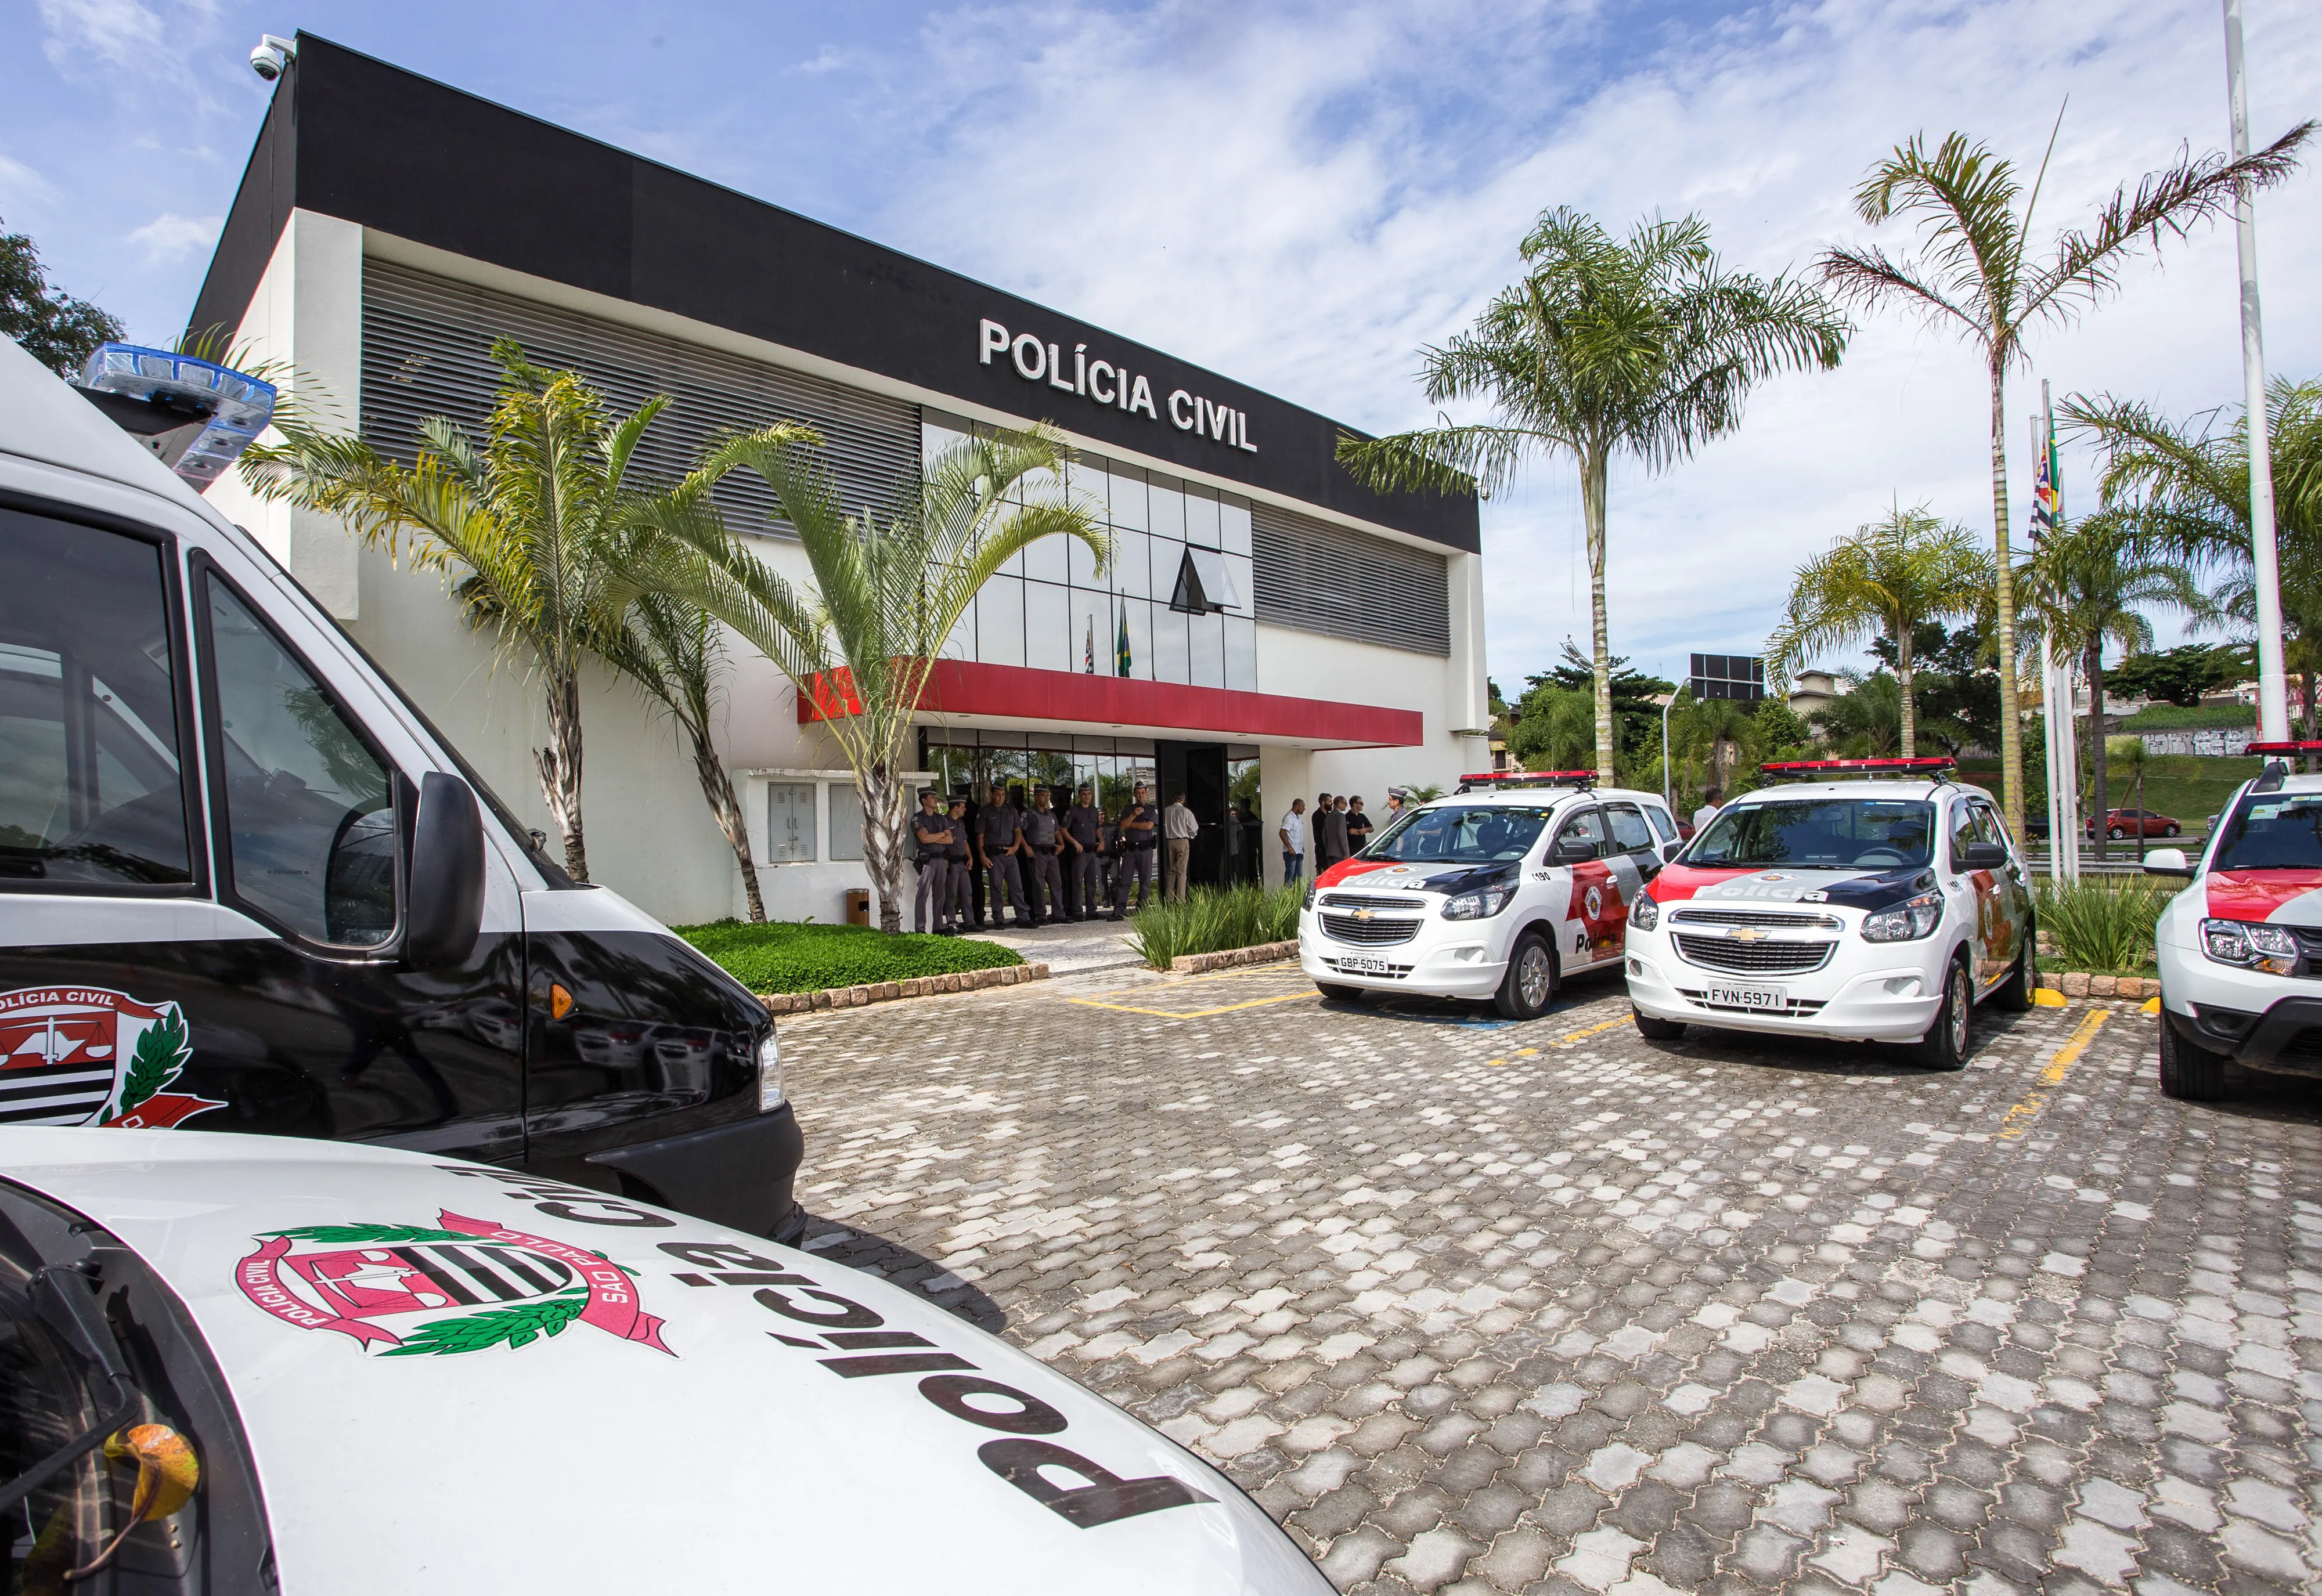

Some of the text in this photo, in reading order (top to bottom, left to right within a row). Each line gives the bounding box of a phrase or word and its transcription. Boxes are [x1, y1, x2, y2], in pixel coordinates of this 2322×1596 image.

[980, 319, 1257, 453] POLÍCIA CIVIL
[1337, 876, 1426, 889] Polícia
[1691, 884, 1829, 902] Polícia
[66, 992, 114, 1006] CIVIL
[246, 1260, 329, 1326] POLÍCIA CIVIL
[491, 1231, 628, 1303] SÃO PAULO
[657, 1242, 1221, 1529] Polícia
